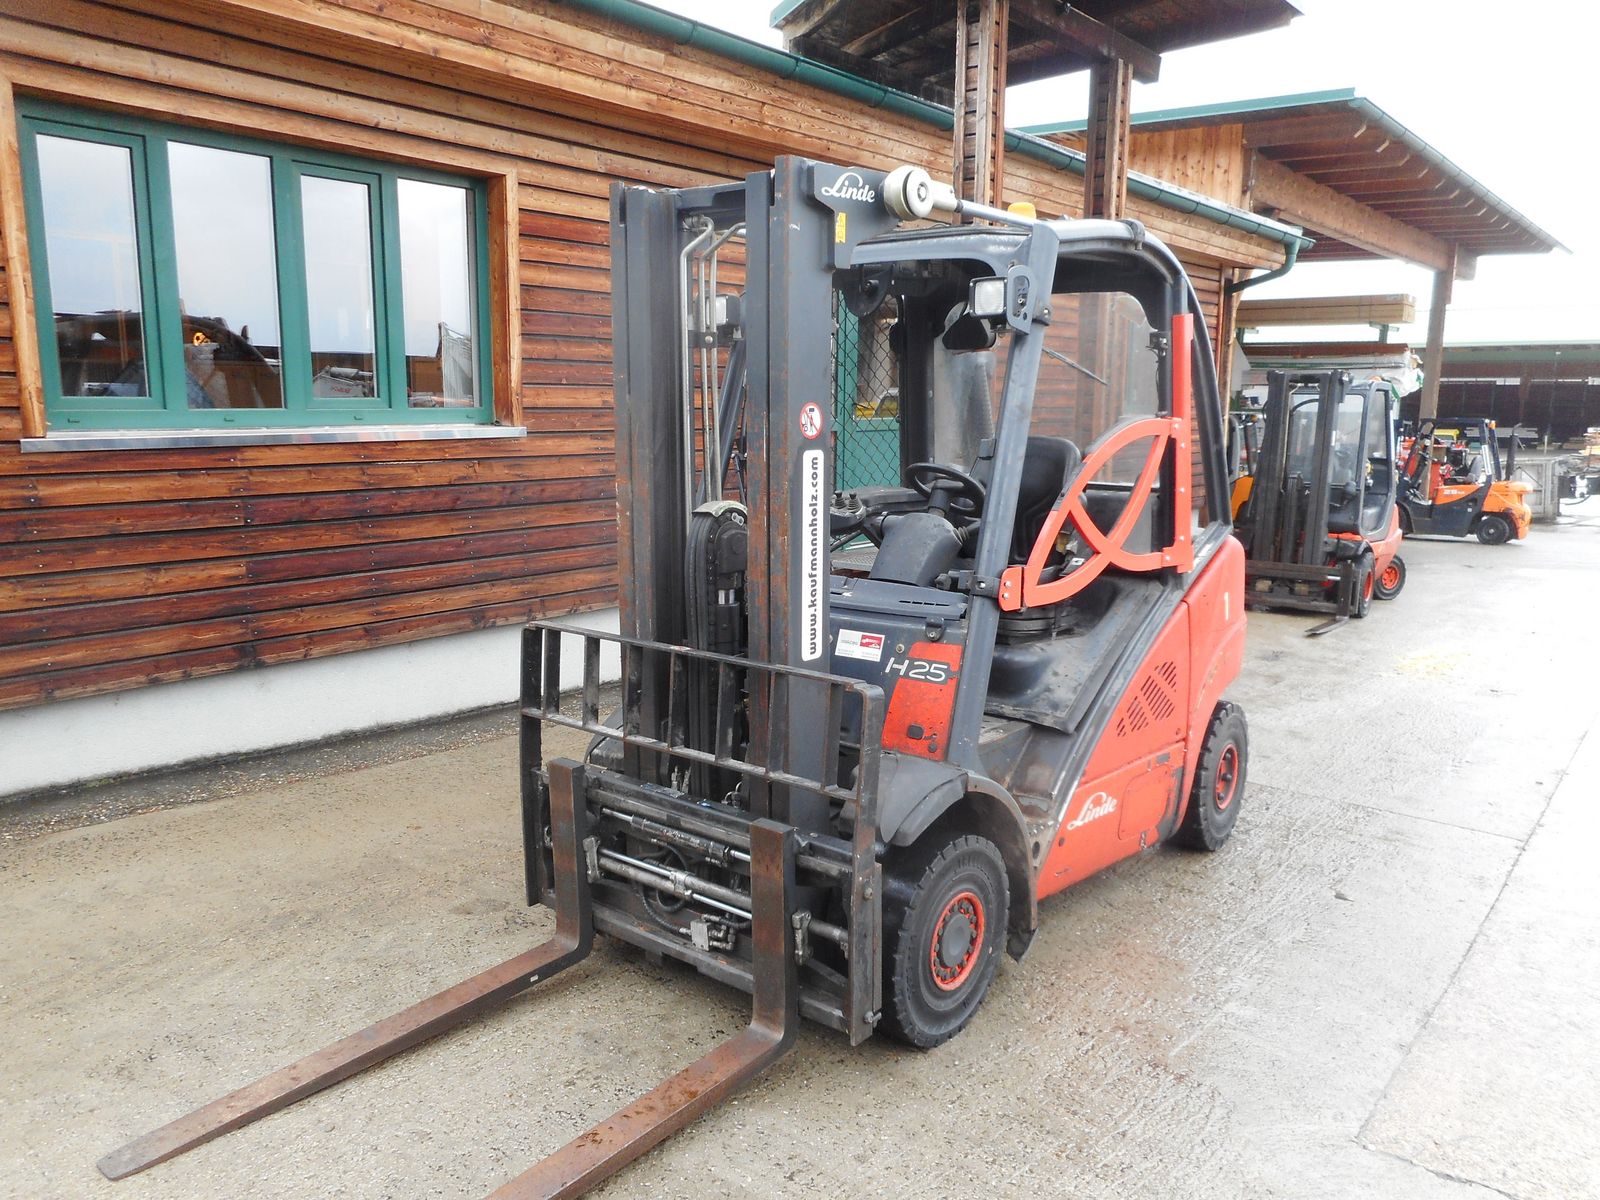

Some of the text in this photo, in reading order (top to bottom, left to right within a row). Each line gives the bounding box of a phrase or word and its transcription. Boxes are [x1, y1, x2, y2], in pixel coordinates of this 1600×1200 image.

[822, 172, 876, 203] Linde
[807, 456, 820, 655] www.kaufmannholz.com
[885, 657, 948, 682] H25
[1068, 792, 1117, 830] Linde
